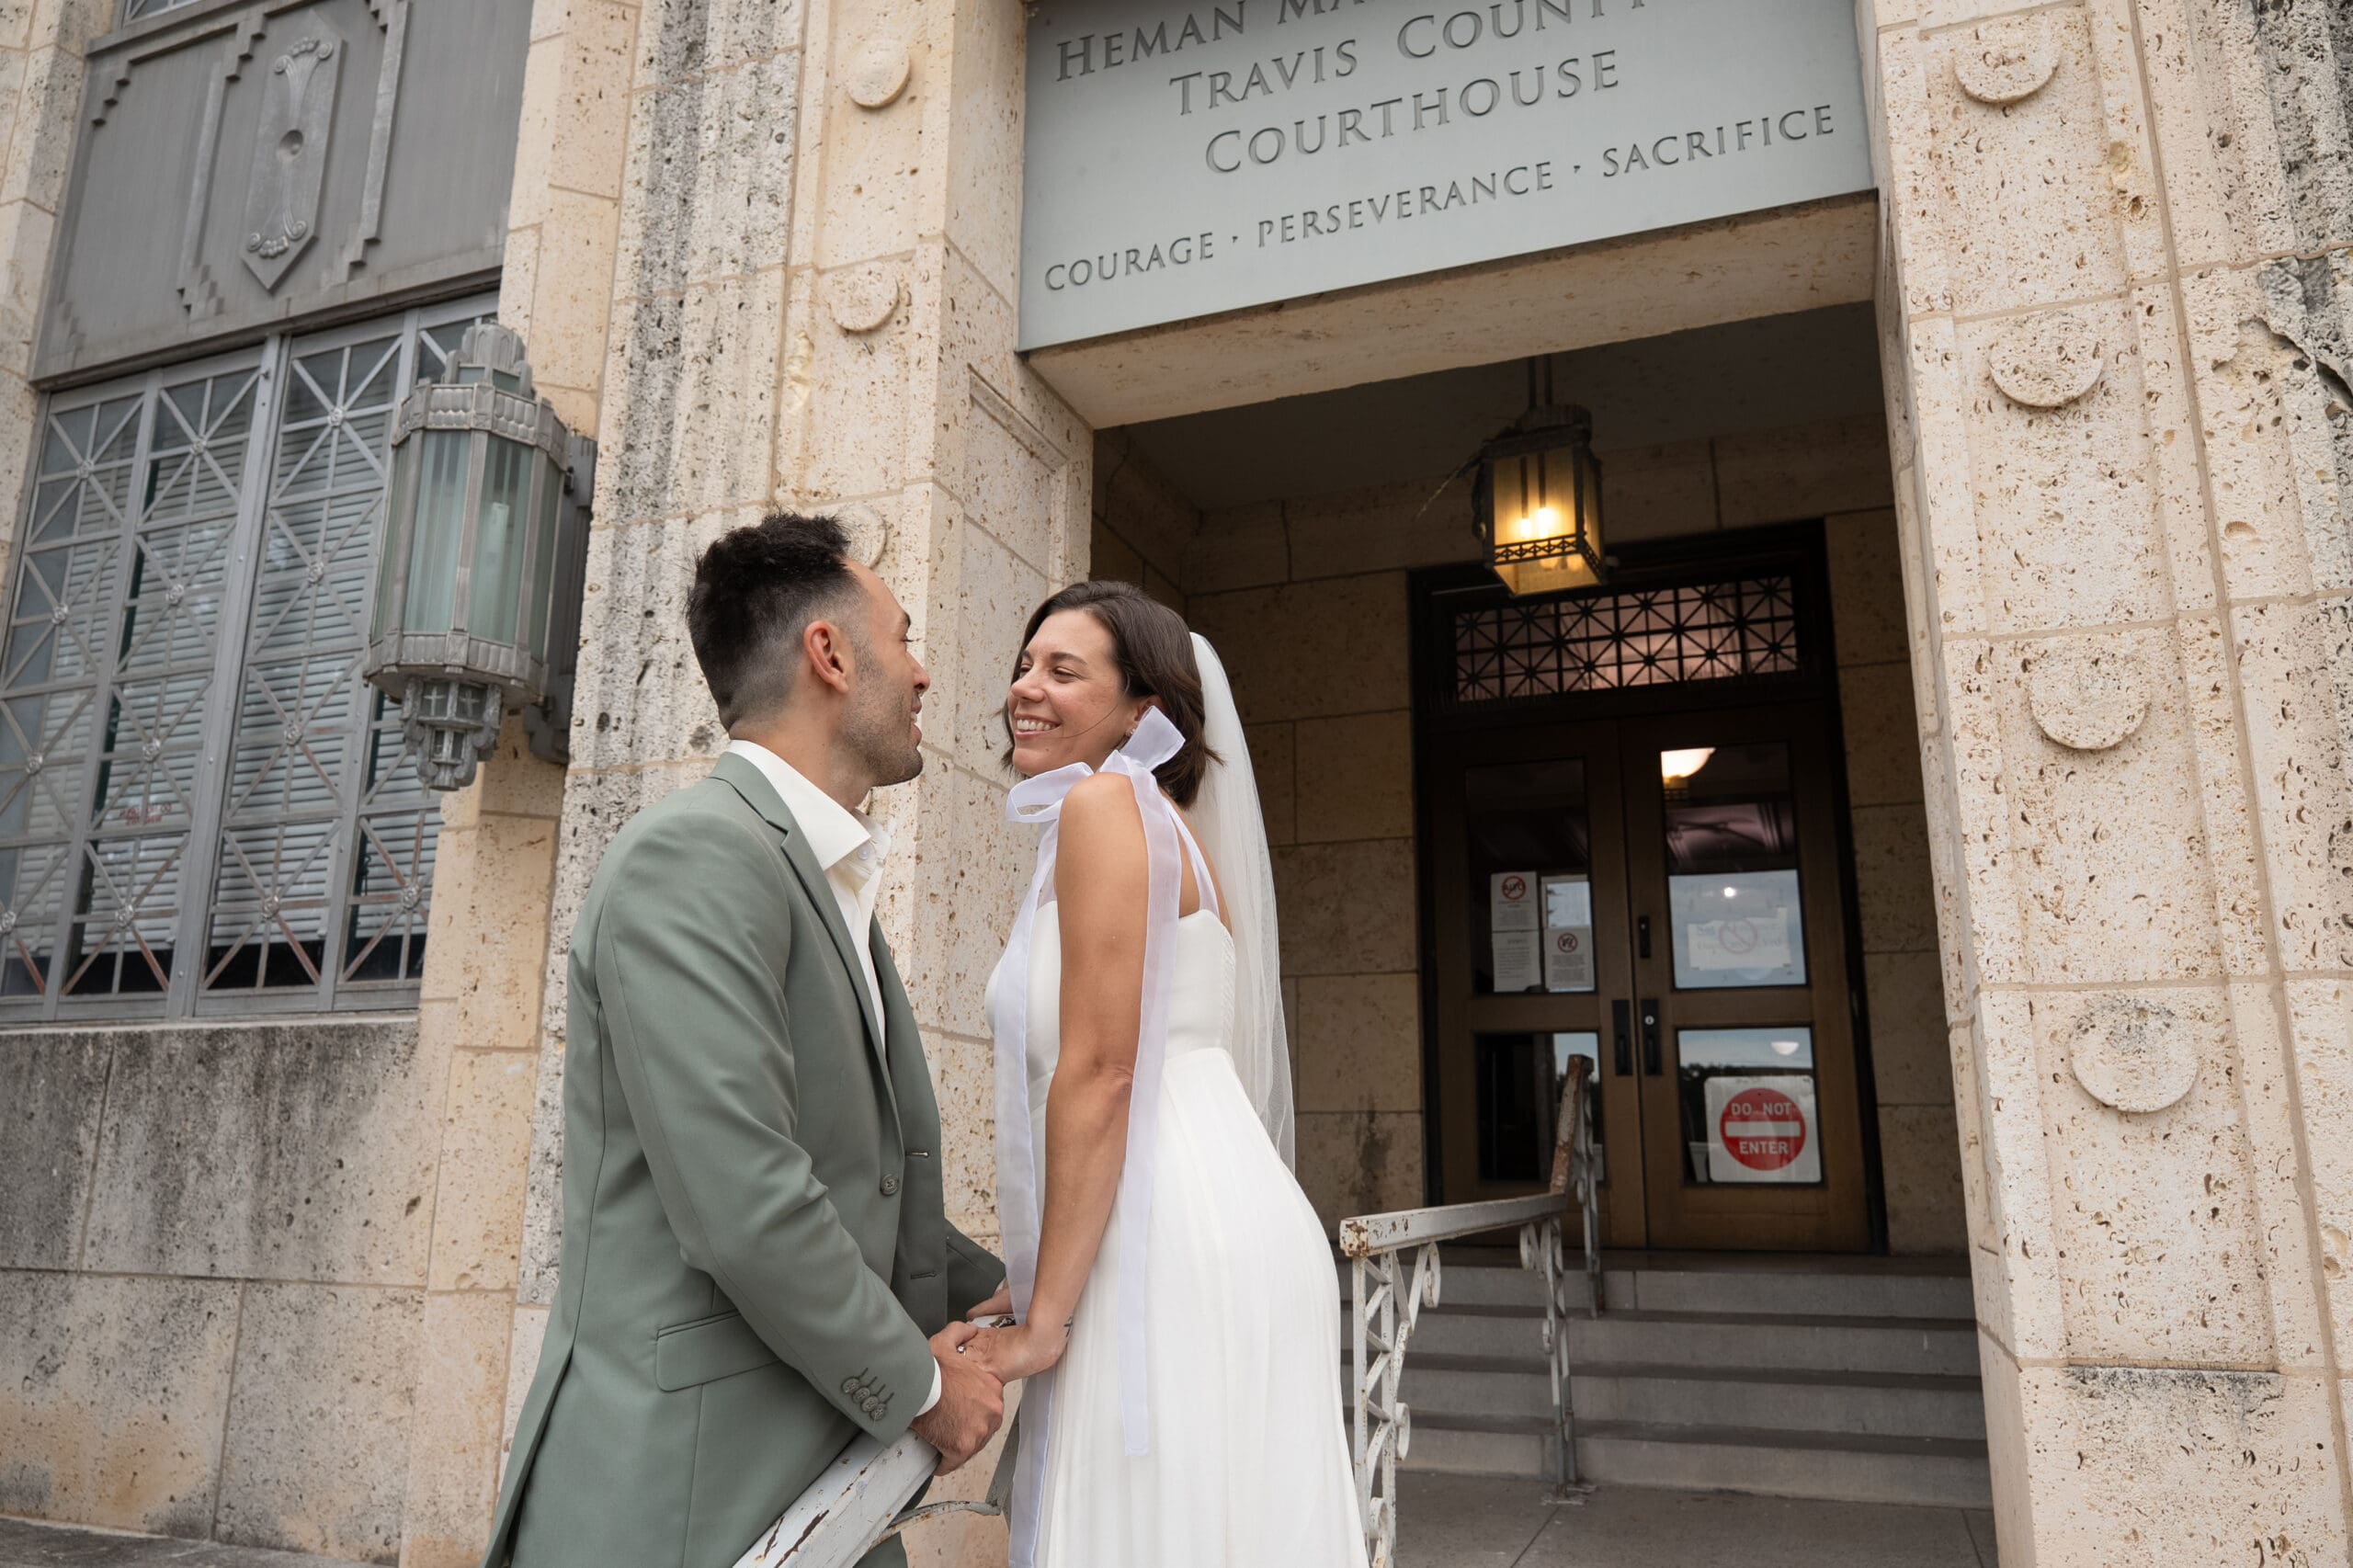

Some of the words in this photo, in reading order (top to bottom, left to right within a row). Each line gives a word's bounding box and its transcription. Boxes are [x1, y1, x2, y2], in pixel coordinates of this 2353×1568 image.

[1055, 0, 1245, 82] HEMAN
[1168, 39, 1358, 116] TRAVIS
[1396, 0, 1645, 59] COUN
[1205, 49, 1619, 173] COURTHOUSE
[1044, 232, 1214, 292] COURAGE
[1257, 161, 1554, 249] PERSEVERANCE
[1601, 104, 1836, 178] SACRIFICE
[1731, 1102, 1753, 1117] DO
[1762, 1102, 1793, 1117] NOT
[1738, 1141, 1790, 1155] ENTER
